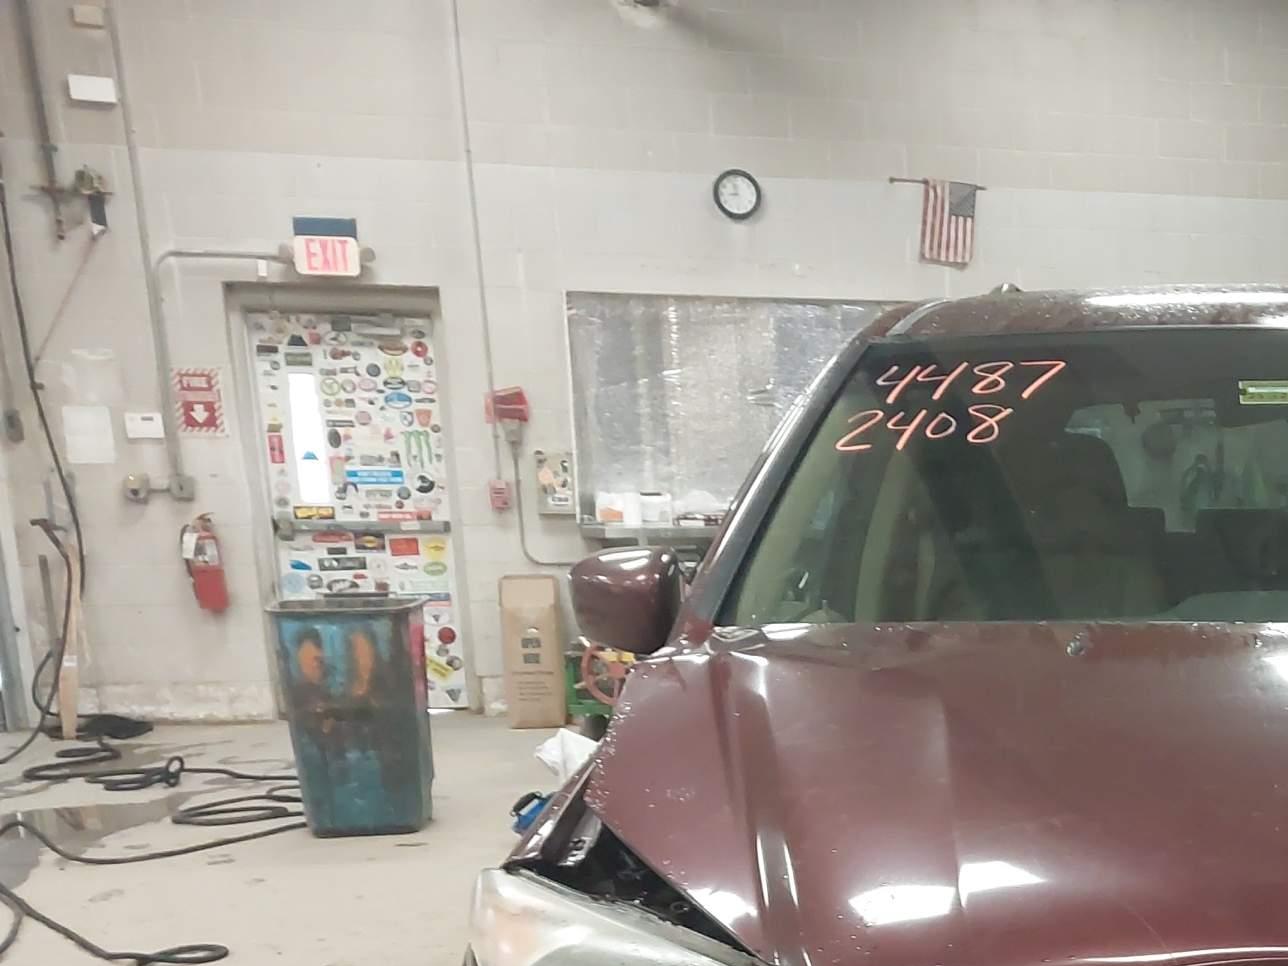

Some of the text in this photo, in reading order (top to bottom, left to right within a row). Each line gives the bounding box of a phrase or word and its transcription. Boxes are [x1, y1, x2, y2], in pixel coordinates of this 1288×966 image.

[304, 238, 349, 272] EXIT
[876, 361, 1067, 404] 4487
[835, 404, 1014, 451] 2408
